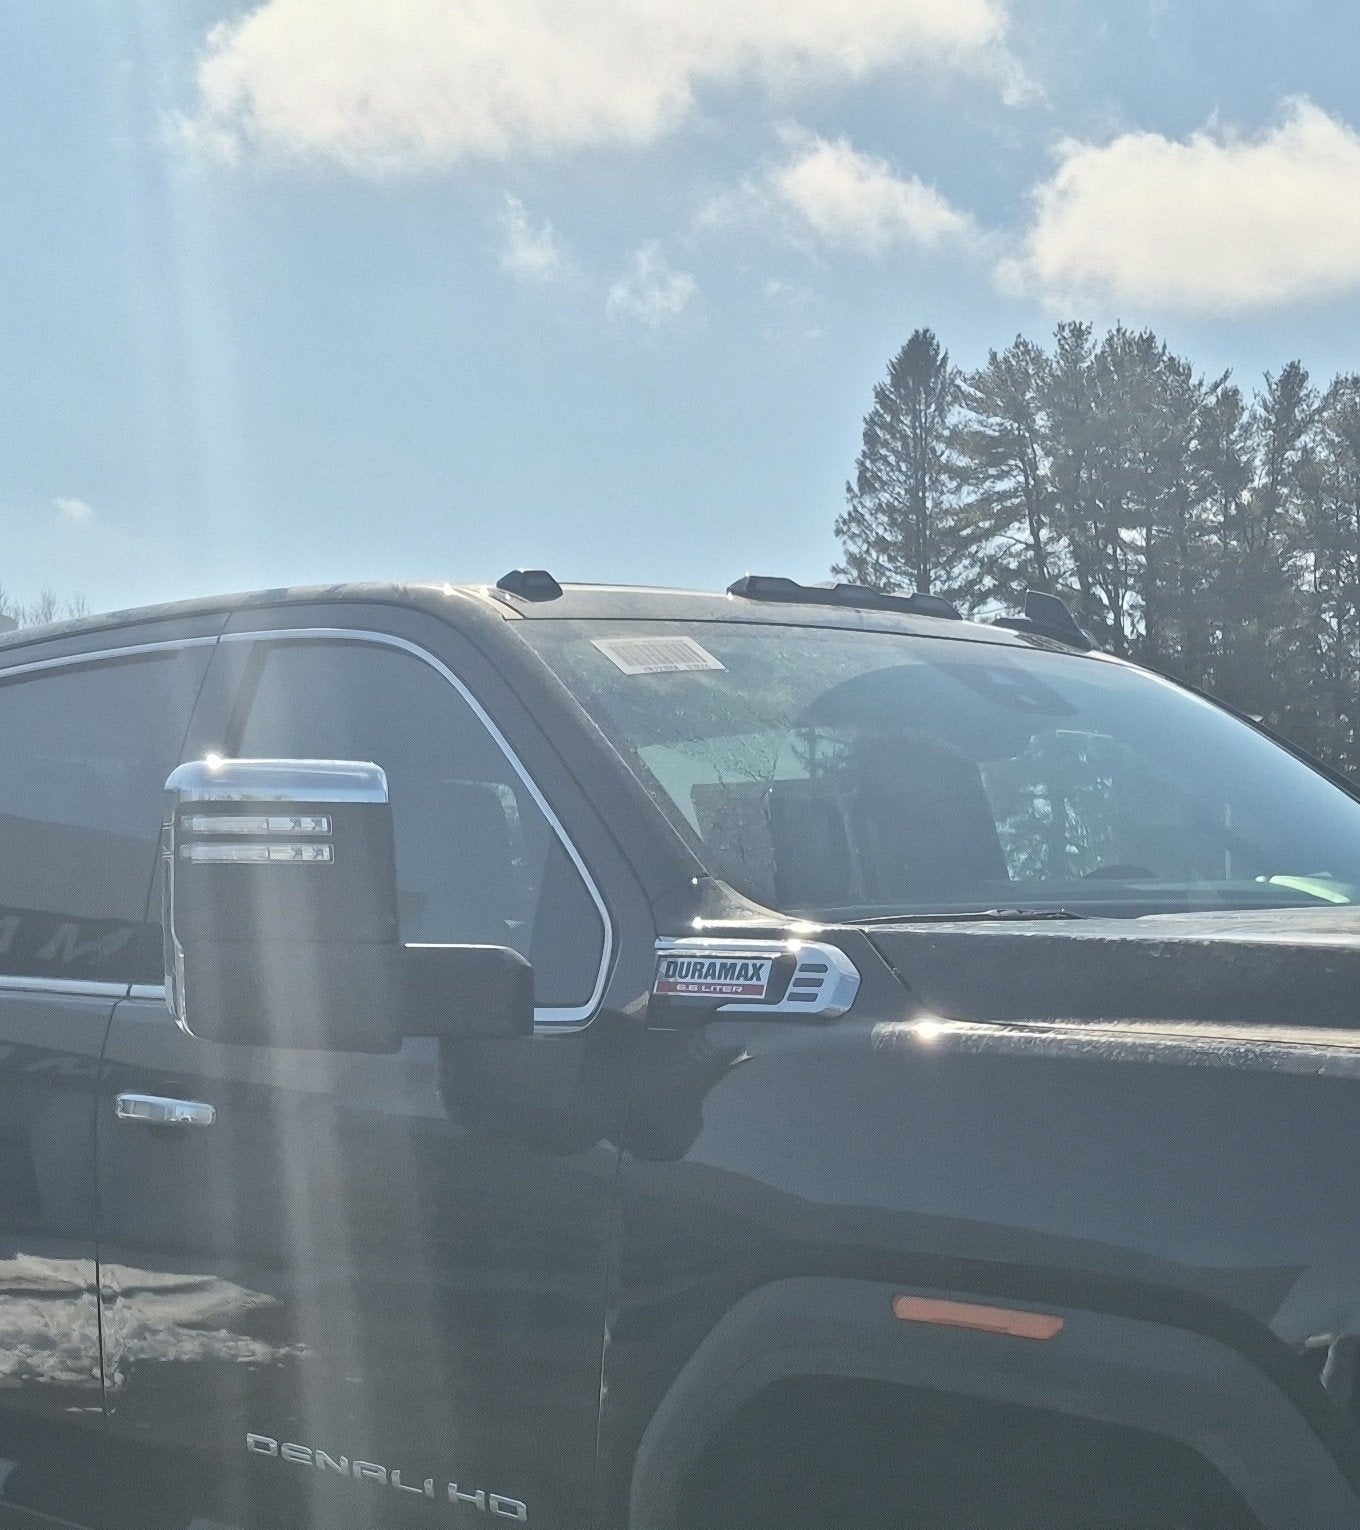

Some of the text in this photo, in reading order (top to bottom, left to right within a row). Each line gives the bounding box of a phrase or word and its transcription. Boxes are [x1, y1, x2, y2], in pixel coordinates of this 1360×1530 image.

[665, 960, 765, 981] DURAMAX
[676, 983, 743, 993] 6.6 LITER
[246, 1432, 527, 1522] DENALI HD
